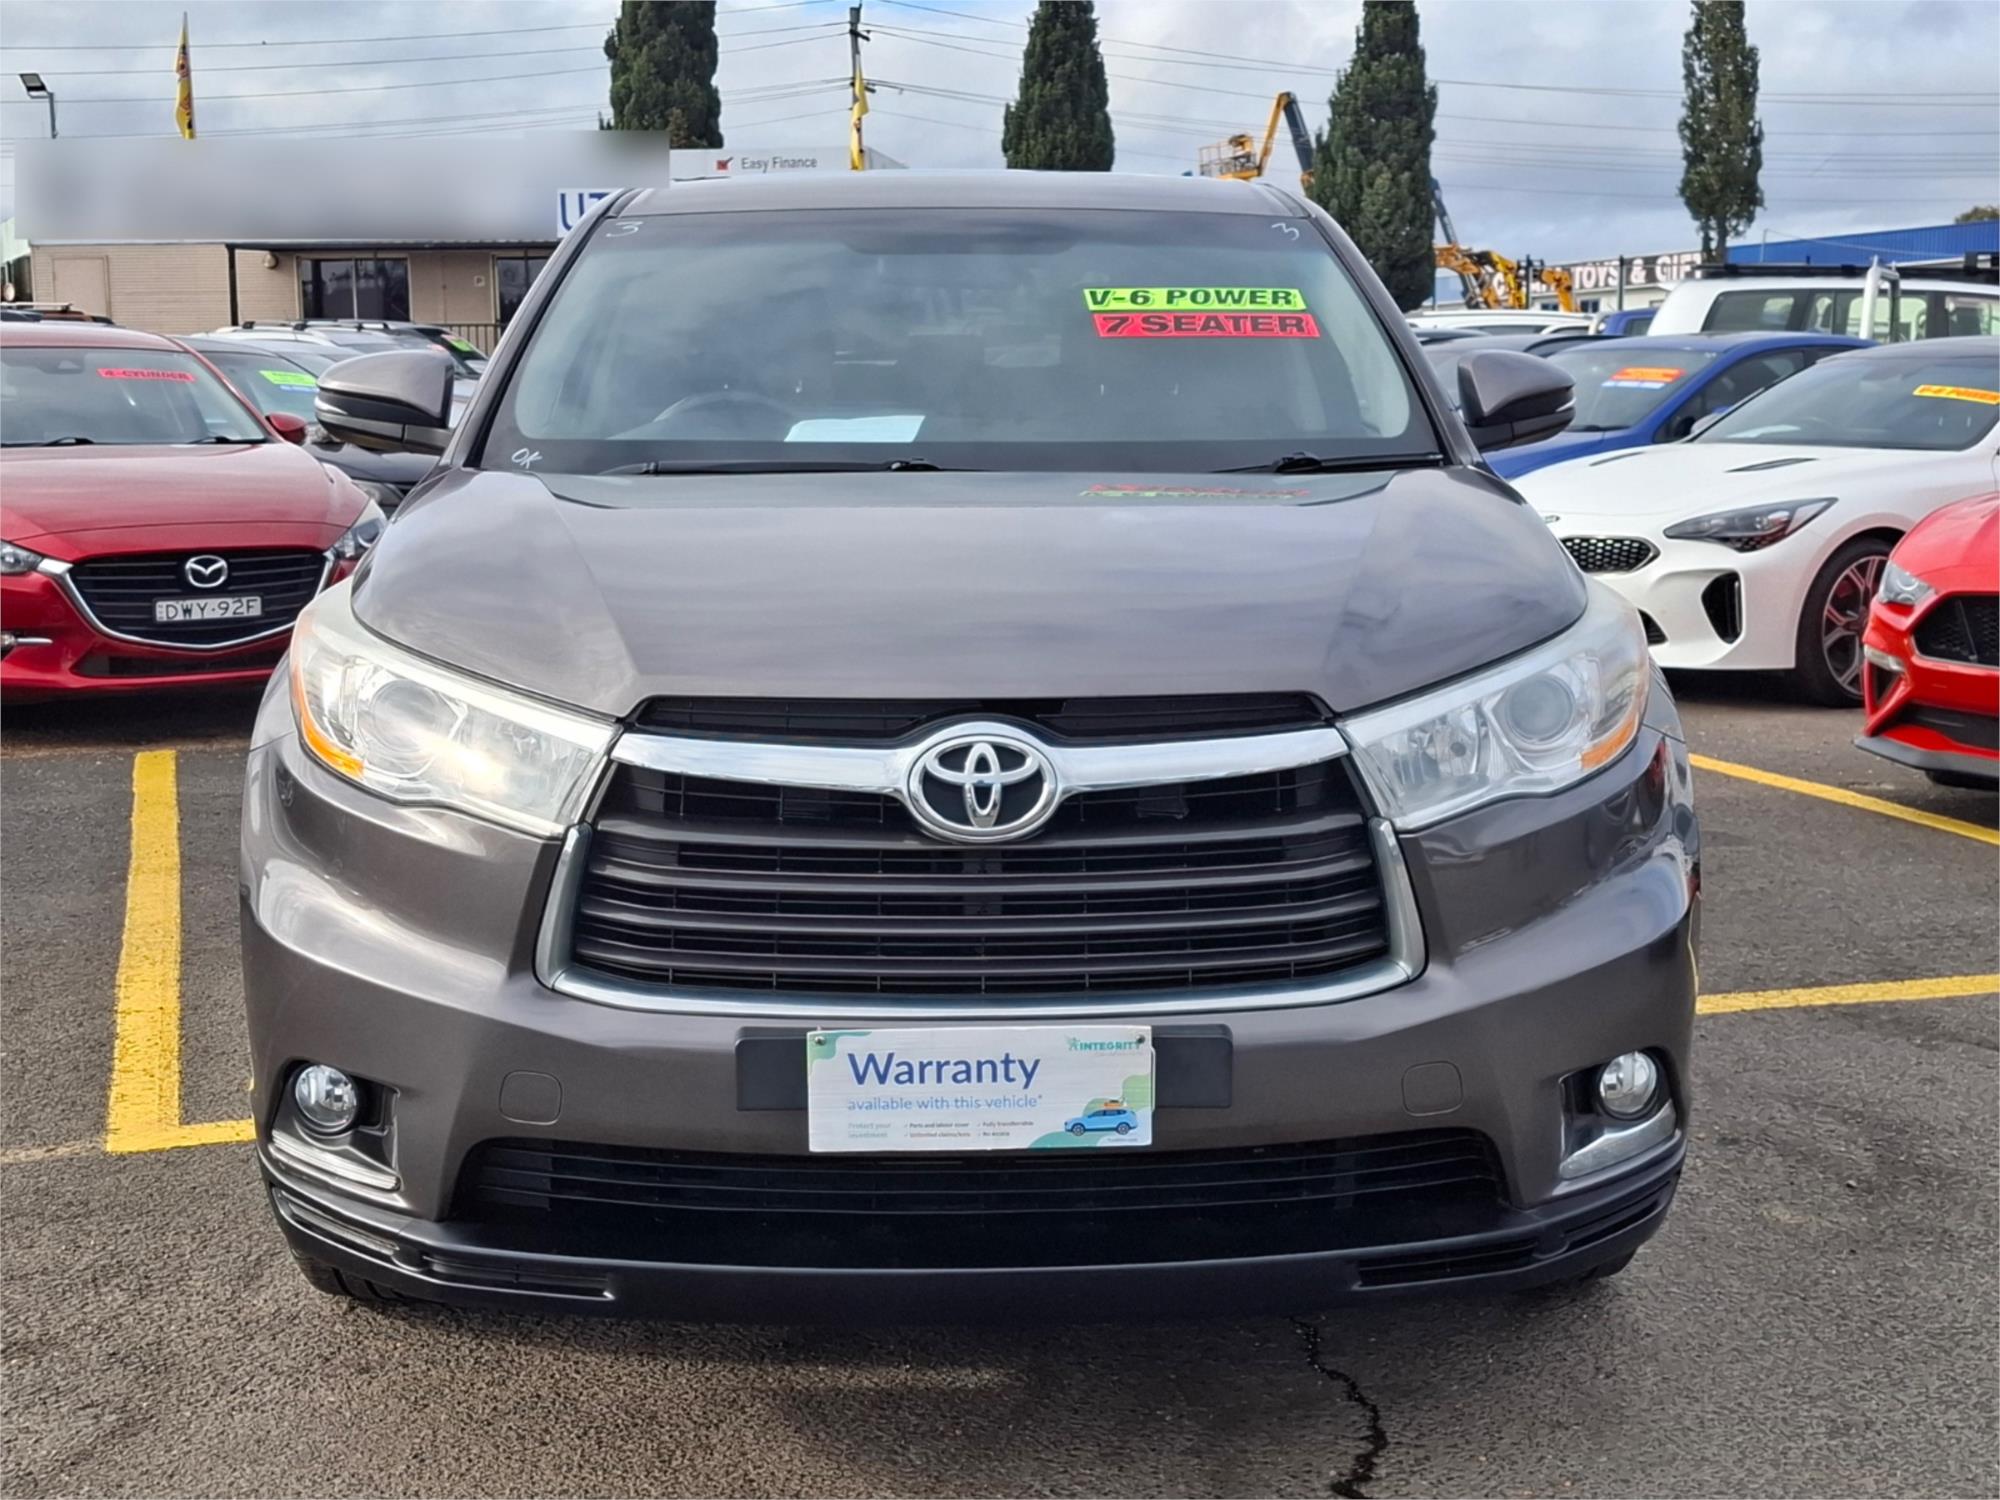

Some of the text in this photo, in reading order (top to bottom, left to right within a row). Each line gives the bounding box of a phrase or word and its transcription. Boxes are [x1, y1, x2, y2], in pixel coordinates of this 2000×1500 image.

[740, 156, 818, 173] Easy Finance
[560, 193, 610, 231] U
[1573, 260, 1620, 290] TOYS
[1629, 256, 1647, 284] &
[1088, 288, 1298, 307] V-6 POWER
[1102, 315, 1309, 334] 7 SEATER
[847, 1052, 1041, 1090] Warranty
[847, 1097, 912, 1111] available
[916, 1096, 950, 1110] with
[953, 1095, 982, 1109] this
